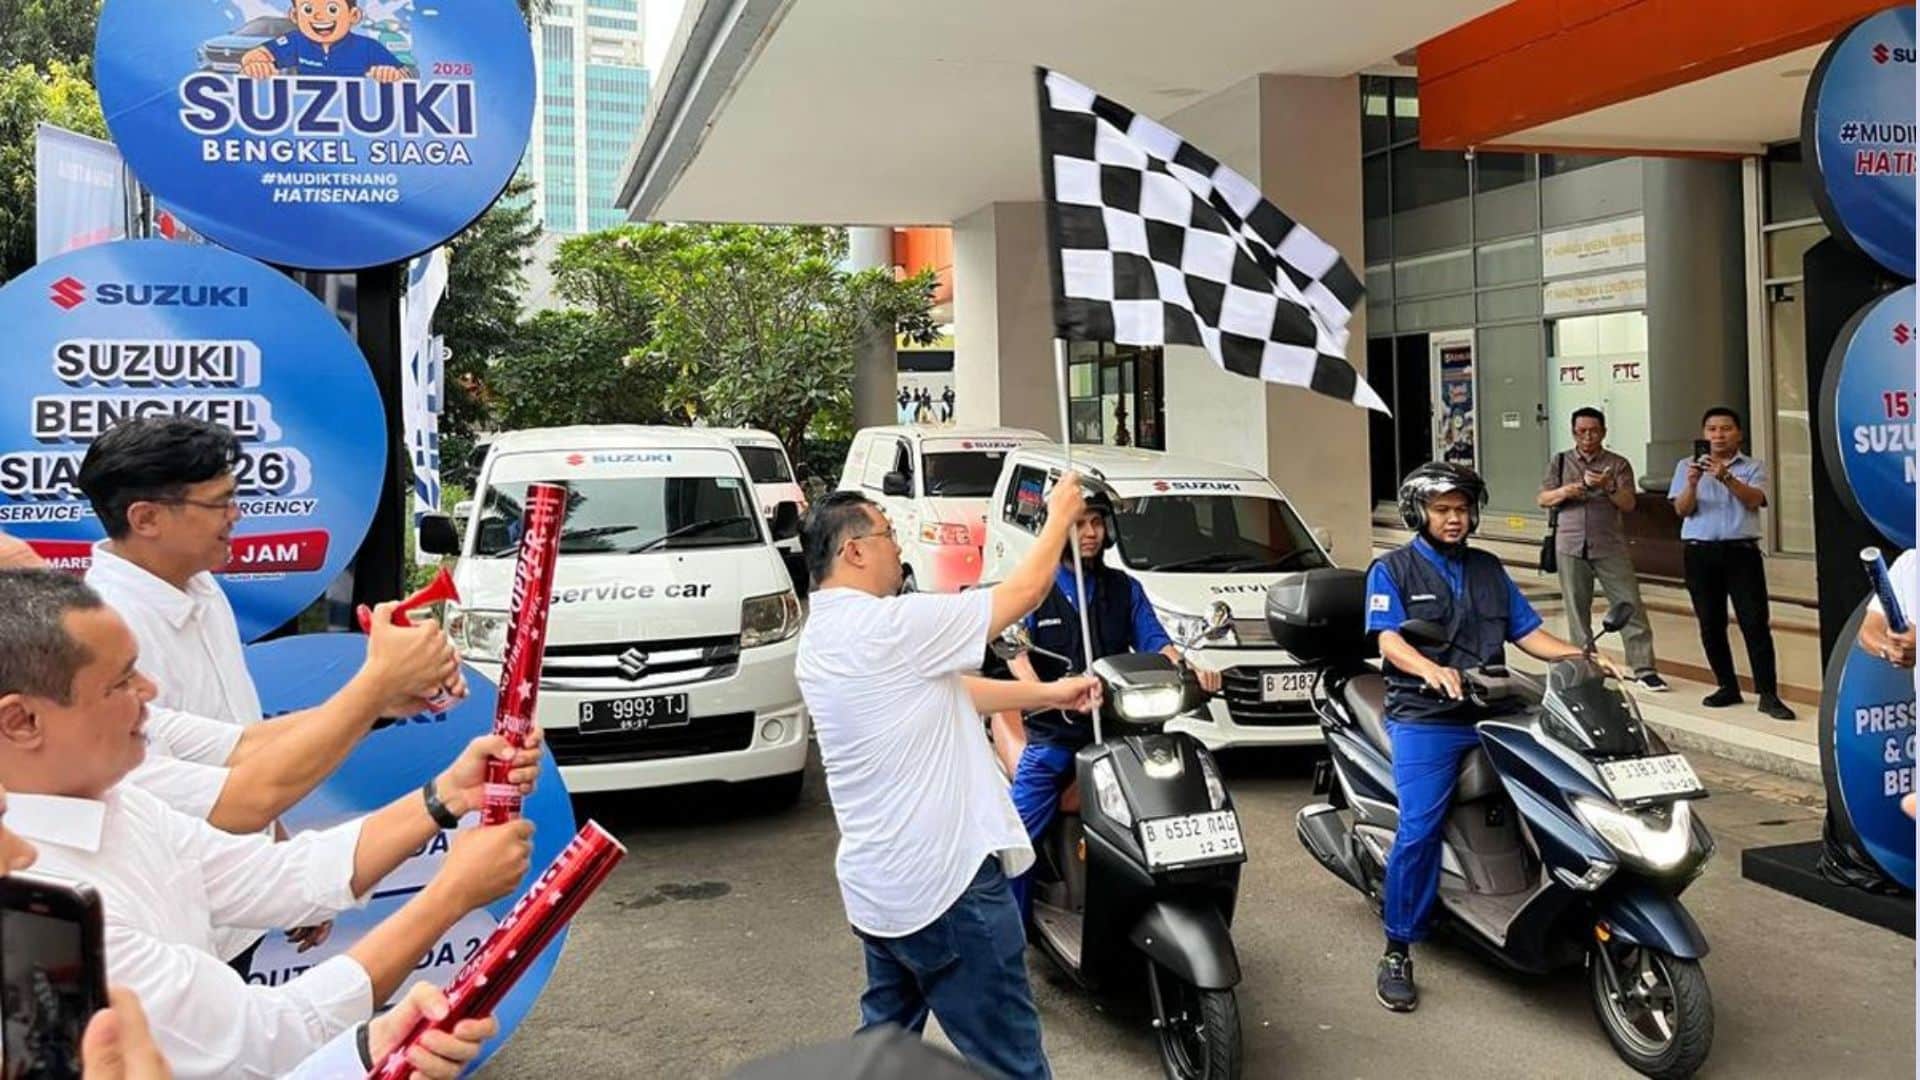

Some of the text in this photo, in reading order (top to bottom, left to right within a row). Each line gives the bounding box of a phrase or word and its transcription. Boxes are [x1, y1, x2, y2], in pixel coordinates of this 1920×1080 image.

[1893, 47, 1916, 63] SU
[433, 62, 473, 76] 2026
[182, 73, 475, 137] SUZUKI
[1841, 123, 1916, 145] #MUDI
[202, 139, 471, 165] BENGKEL SIAGA
[1856, 151, 1916, 175] HATI
[261, 172, 397, 186] #MUDIKTENANG
[273, 188, 400, 203] HATISENANG
[95, 283, 249, 307] SUZUKI
[56, 343, 235, 378] SUZUKI
[1613, 362, 1640, 378] FTC
[1560, 366, 1585, 381] FTC
[1884, 393, 1909, 418] 15
[1854, 425, 1916, 453] SUZU
[592, 453, 673, 463] SUZUKI
[0, 451, 285, 490] SIA 26
[1171, 481, 1241, 491] SUZUKI
[0, 500, 315, 521] SERVICE RGENCY
[45, 556, 90, 569] MARE
[665, 583, 712, 599] car
[1209, 583, 1268, 595] servi
[1266, 675, 1275, 692] B
[582, 694, 687, 722] B 9993 TJ
[1146, 814, 1235, 842] B 6532 RAG
